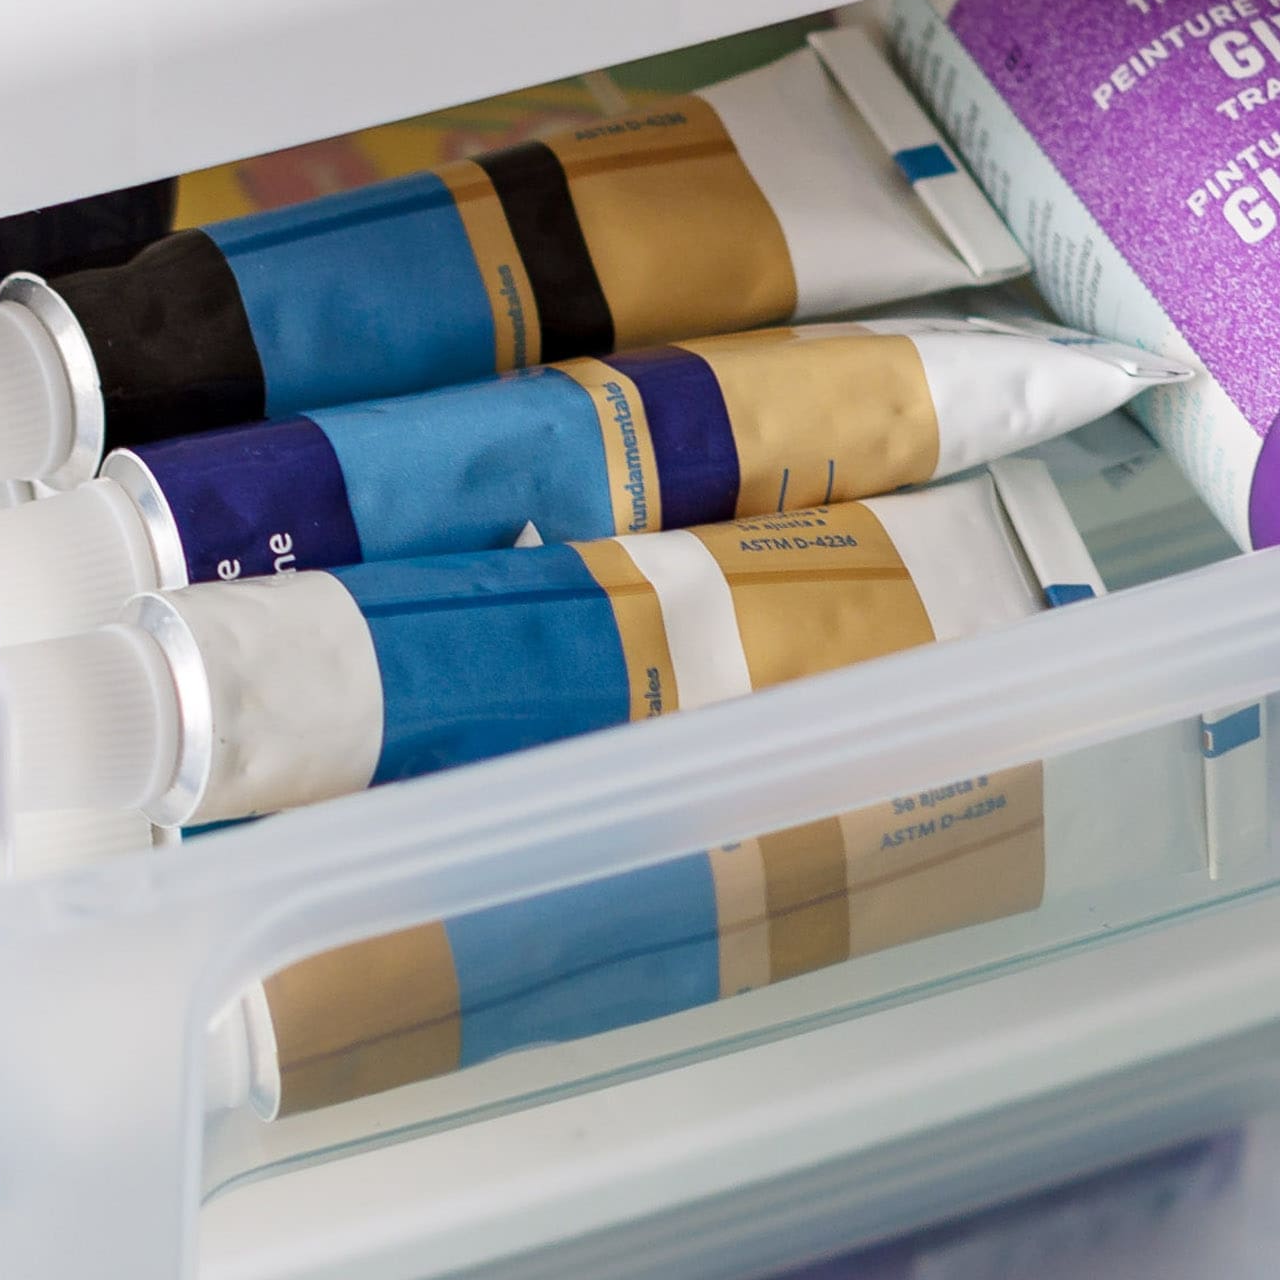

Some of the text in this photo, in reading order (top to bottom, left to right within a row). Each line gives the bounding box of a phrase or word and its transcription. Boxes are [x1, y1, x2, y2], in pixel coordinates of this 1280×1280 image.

[602, 381, 649, 533] fundamentale
[738, 534, 859, 552] ASTM D-4236
